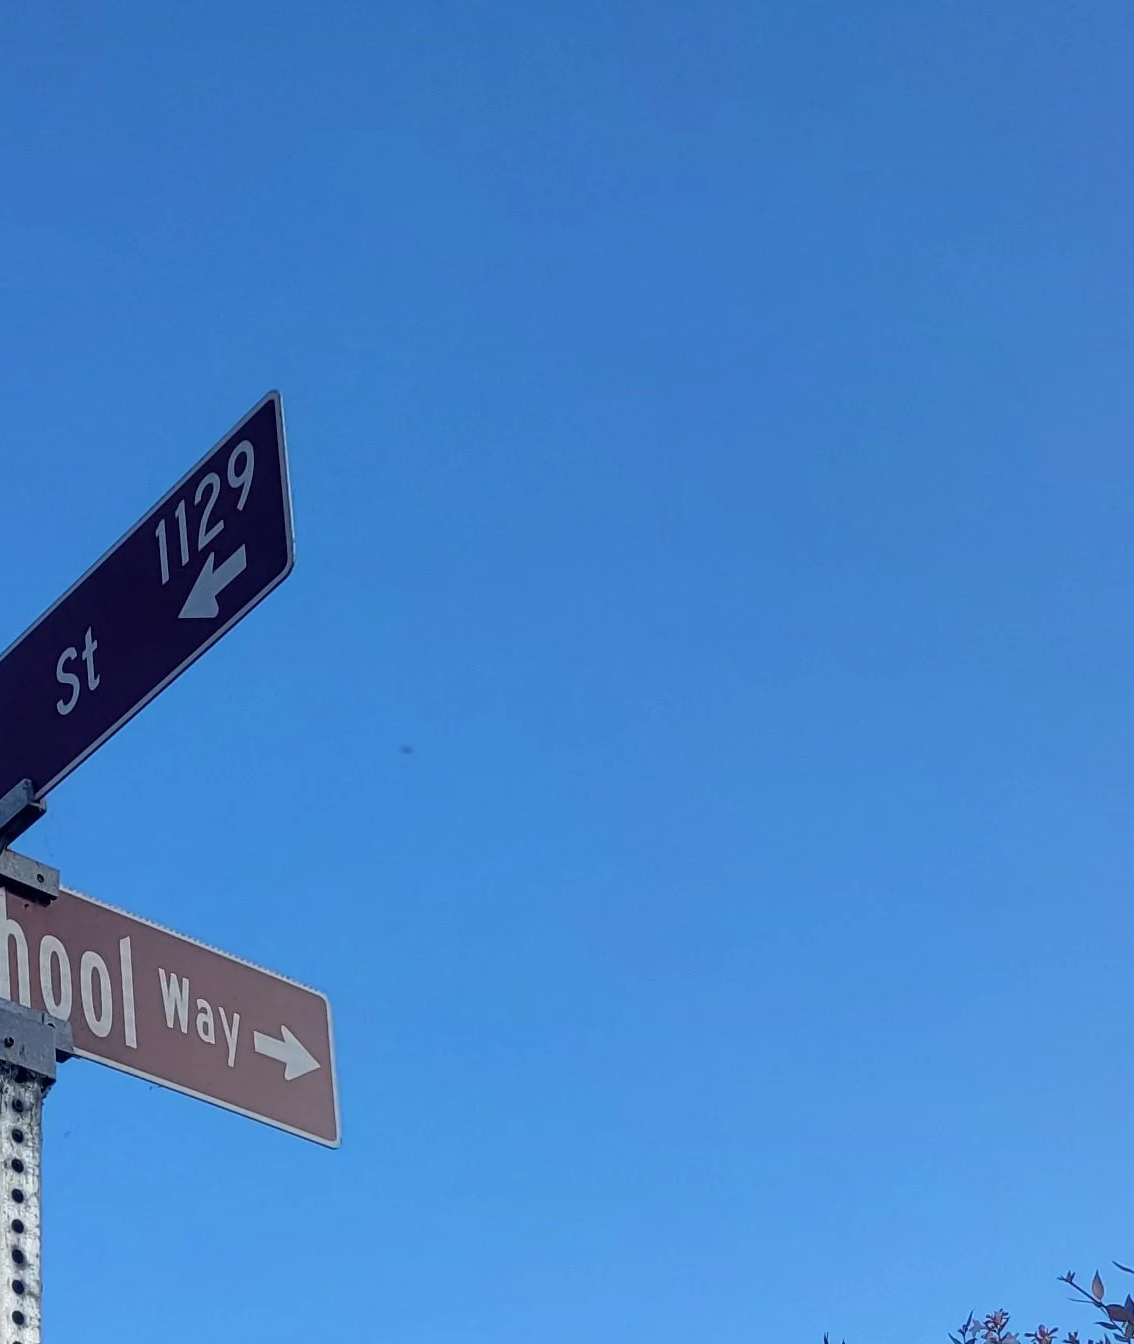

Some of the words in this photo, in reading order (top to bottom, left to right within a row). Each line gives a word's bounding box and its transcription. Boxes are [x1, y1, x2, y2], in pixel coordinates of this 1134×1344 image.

[154, 439, 255, 586] 1129
[56, 626, 100, 716] St
[157, 967, 241, 1069] Way
